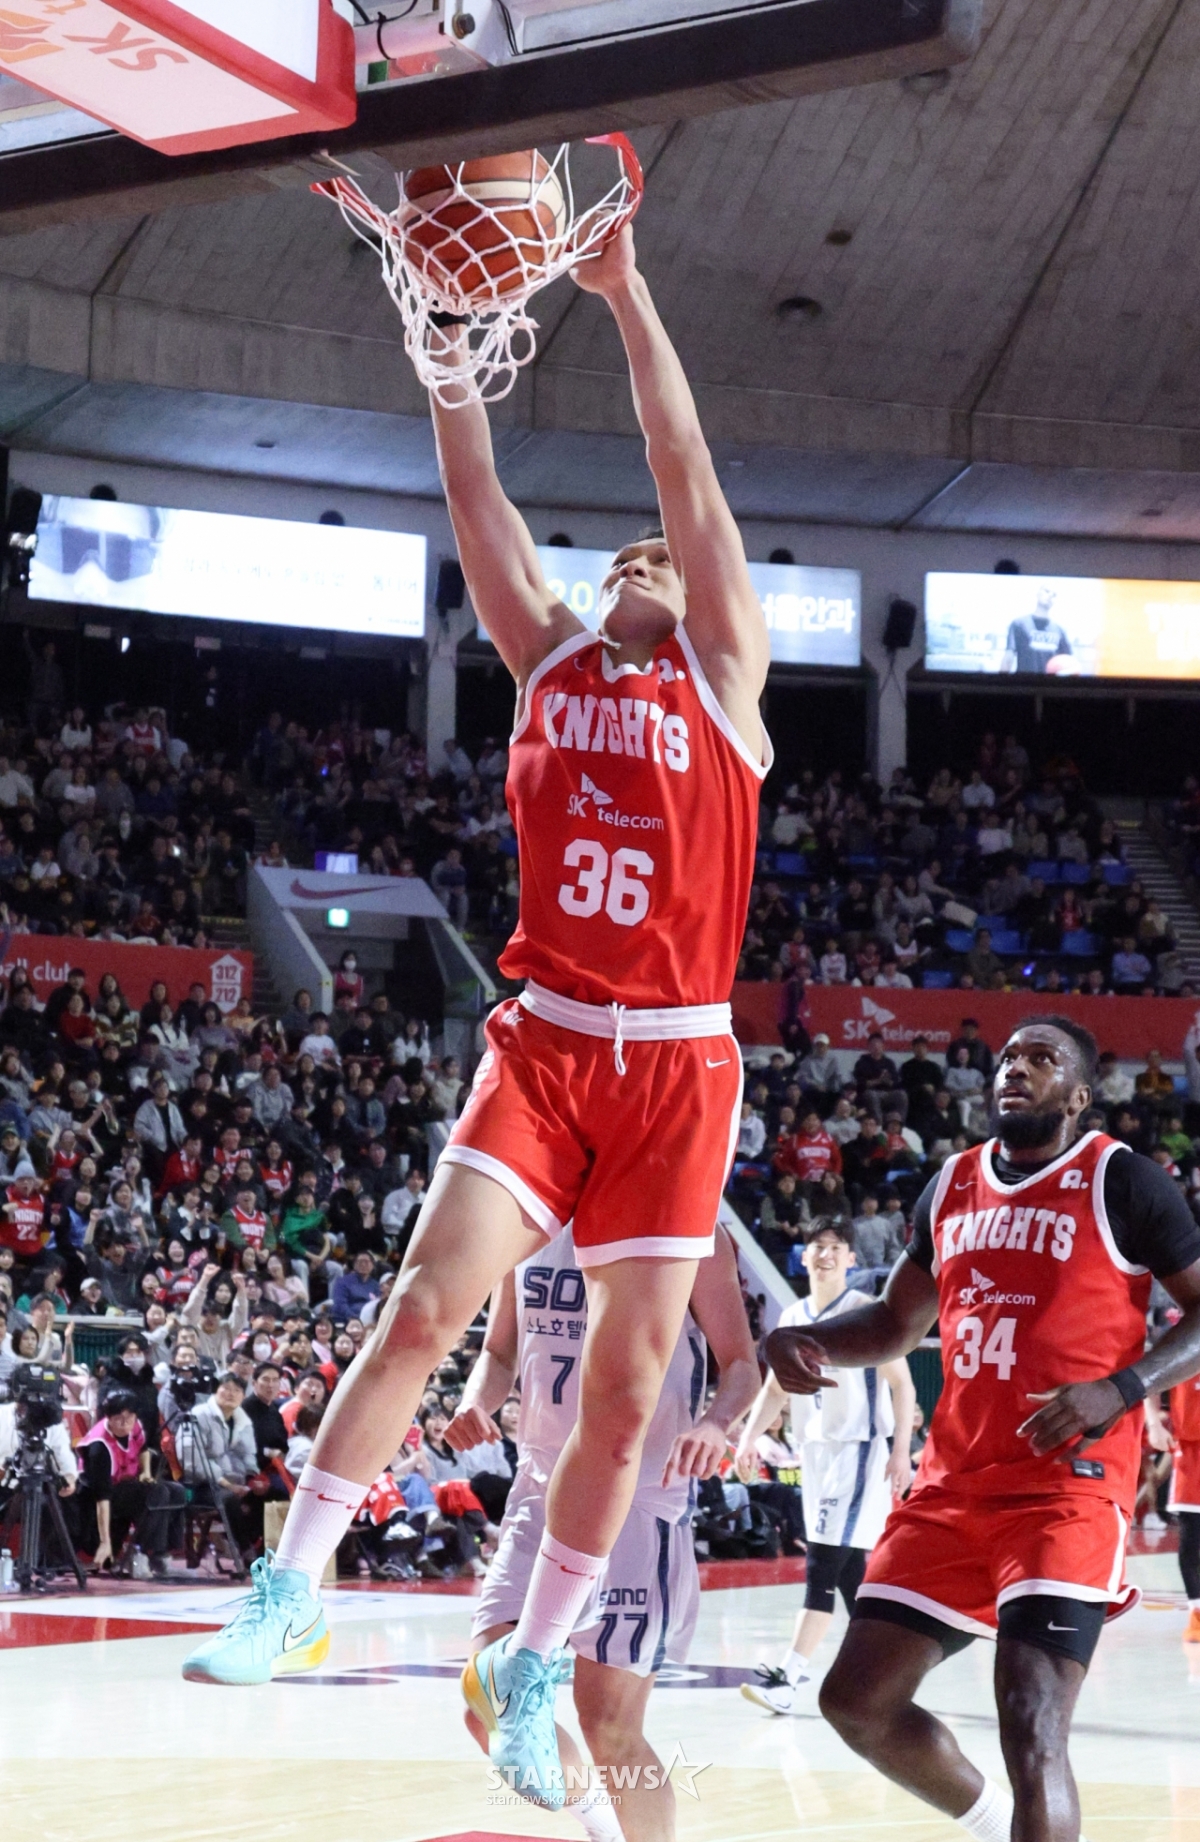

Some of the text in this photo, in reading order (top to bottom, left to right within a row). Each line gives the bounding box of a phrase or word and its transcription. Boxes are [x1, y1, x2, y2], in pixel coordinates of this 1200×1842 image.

[62, 21, 190, 71] SK
[543, 692, 690, 773] KNIGHTS
[567, 793, 665, 831] SK telecom
[558, 838, 655, 927] 36
[216, 965, 238, 980] 312
[843, 1018, 952, 1043] SK telecom
[941, 1205, 1077, 1264] KNIGHTS
[523, 1266, 589, 1313] SO
[959, 1287, 1036, 1305] SK telecom
[526, 1316, 588, 1340] 소노호텔
[953, 1316, 1018, 1381] 34
[550, 1354, 577, 1405] 7
[595, 1613, 649, 1665] 77
